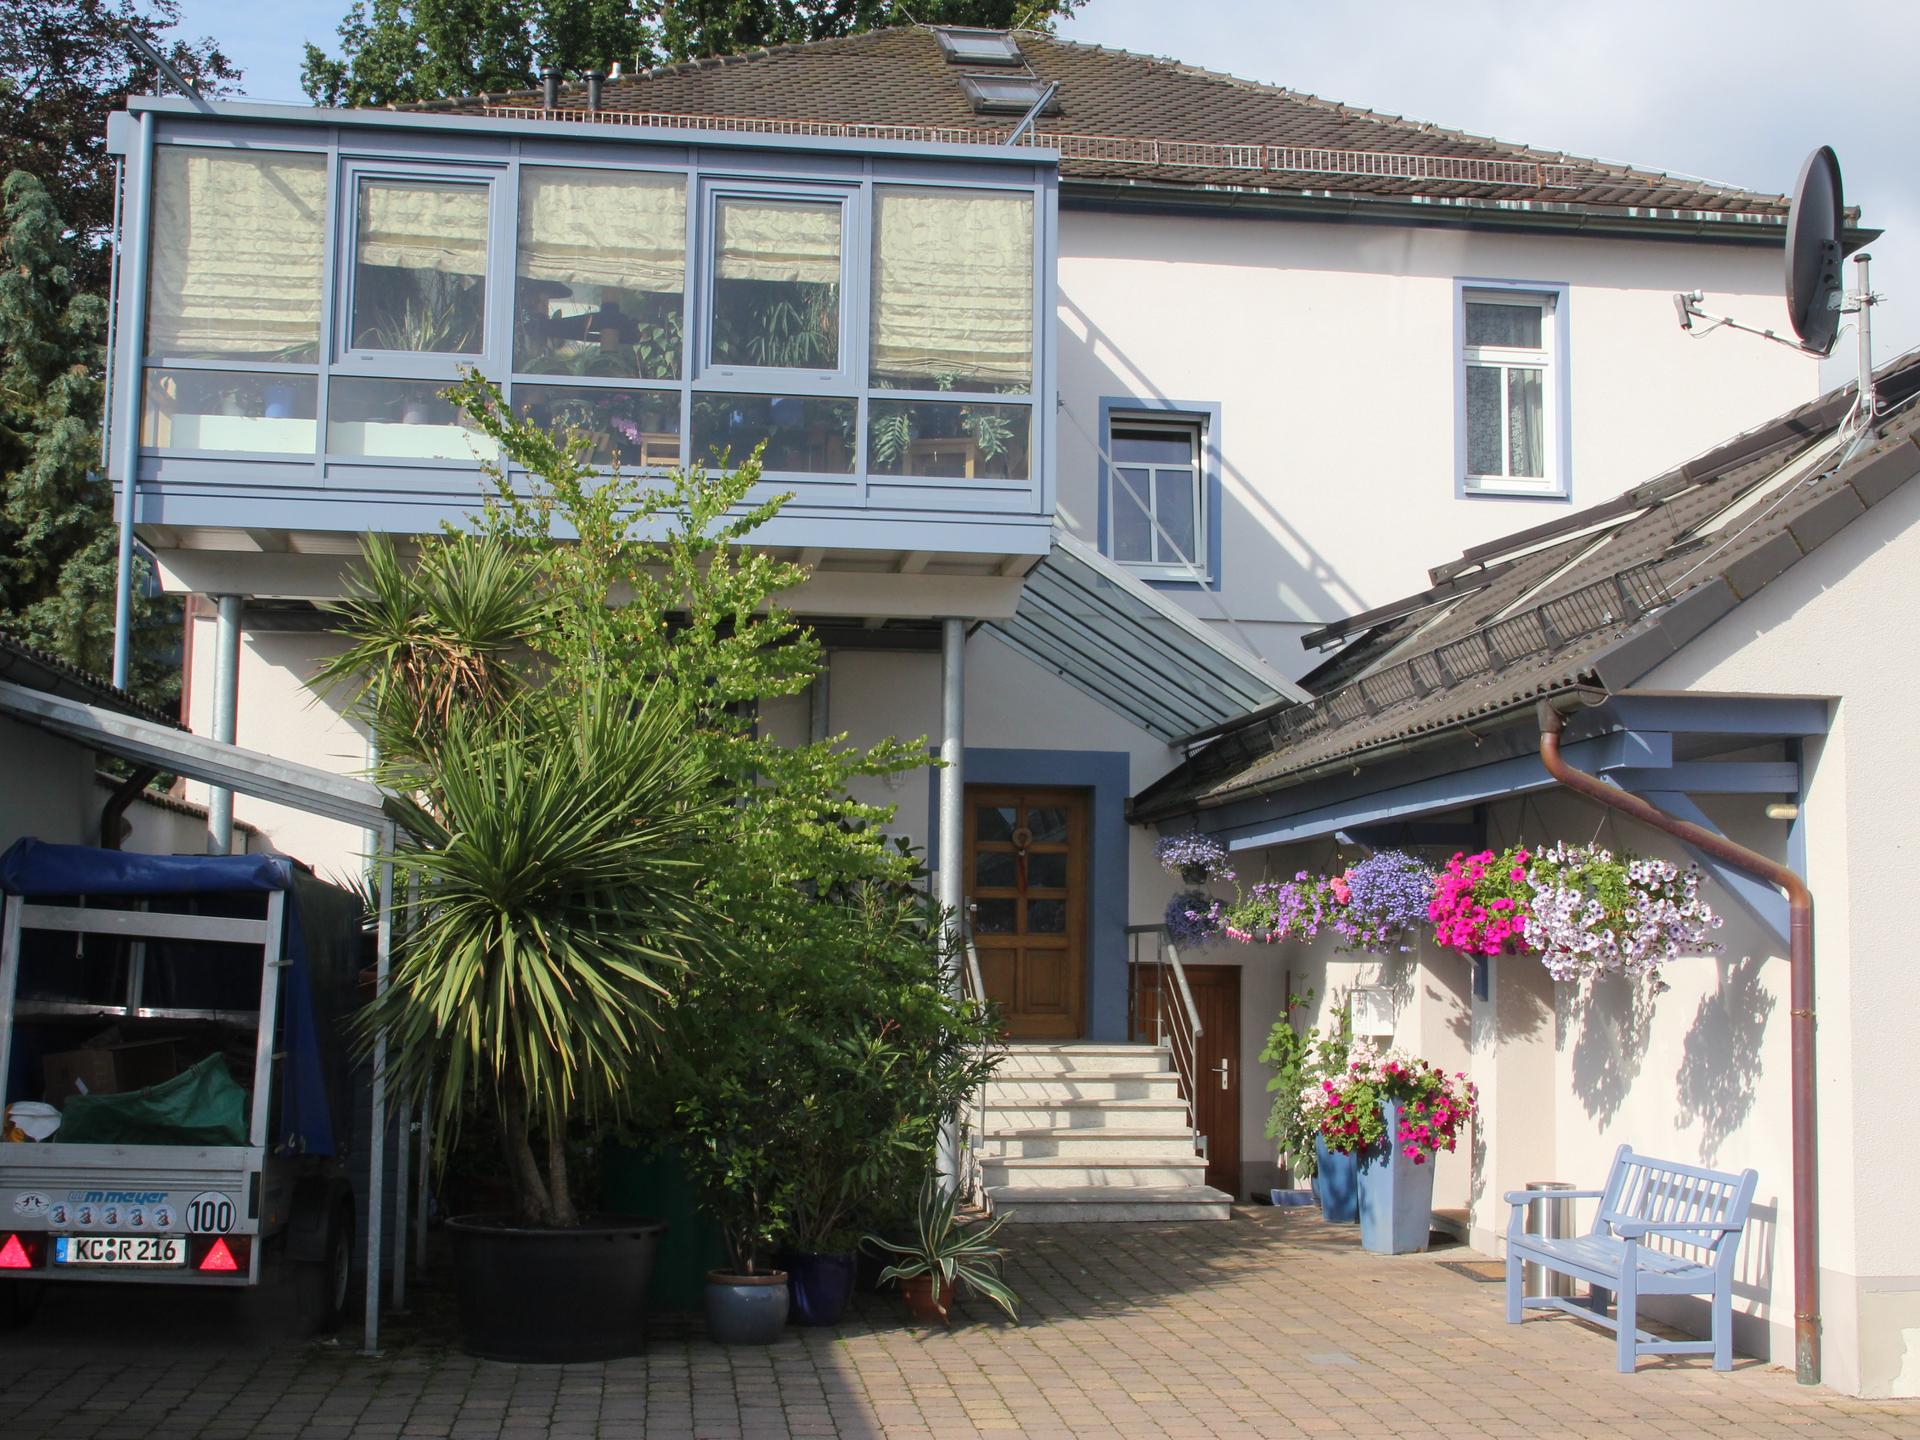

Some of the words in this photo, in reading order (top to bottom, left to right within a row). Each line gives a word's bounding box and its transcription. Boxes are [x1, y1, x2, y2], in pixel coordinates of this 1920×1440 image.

[104, 1192, 168, 1205] meyer
[191, 1201, 231, 1232] 100
[137, 1240, 176, 1260] 216
